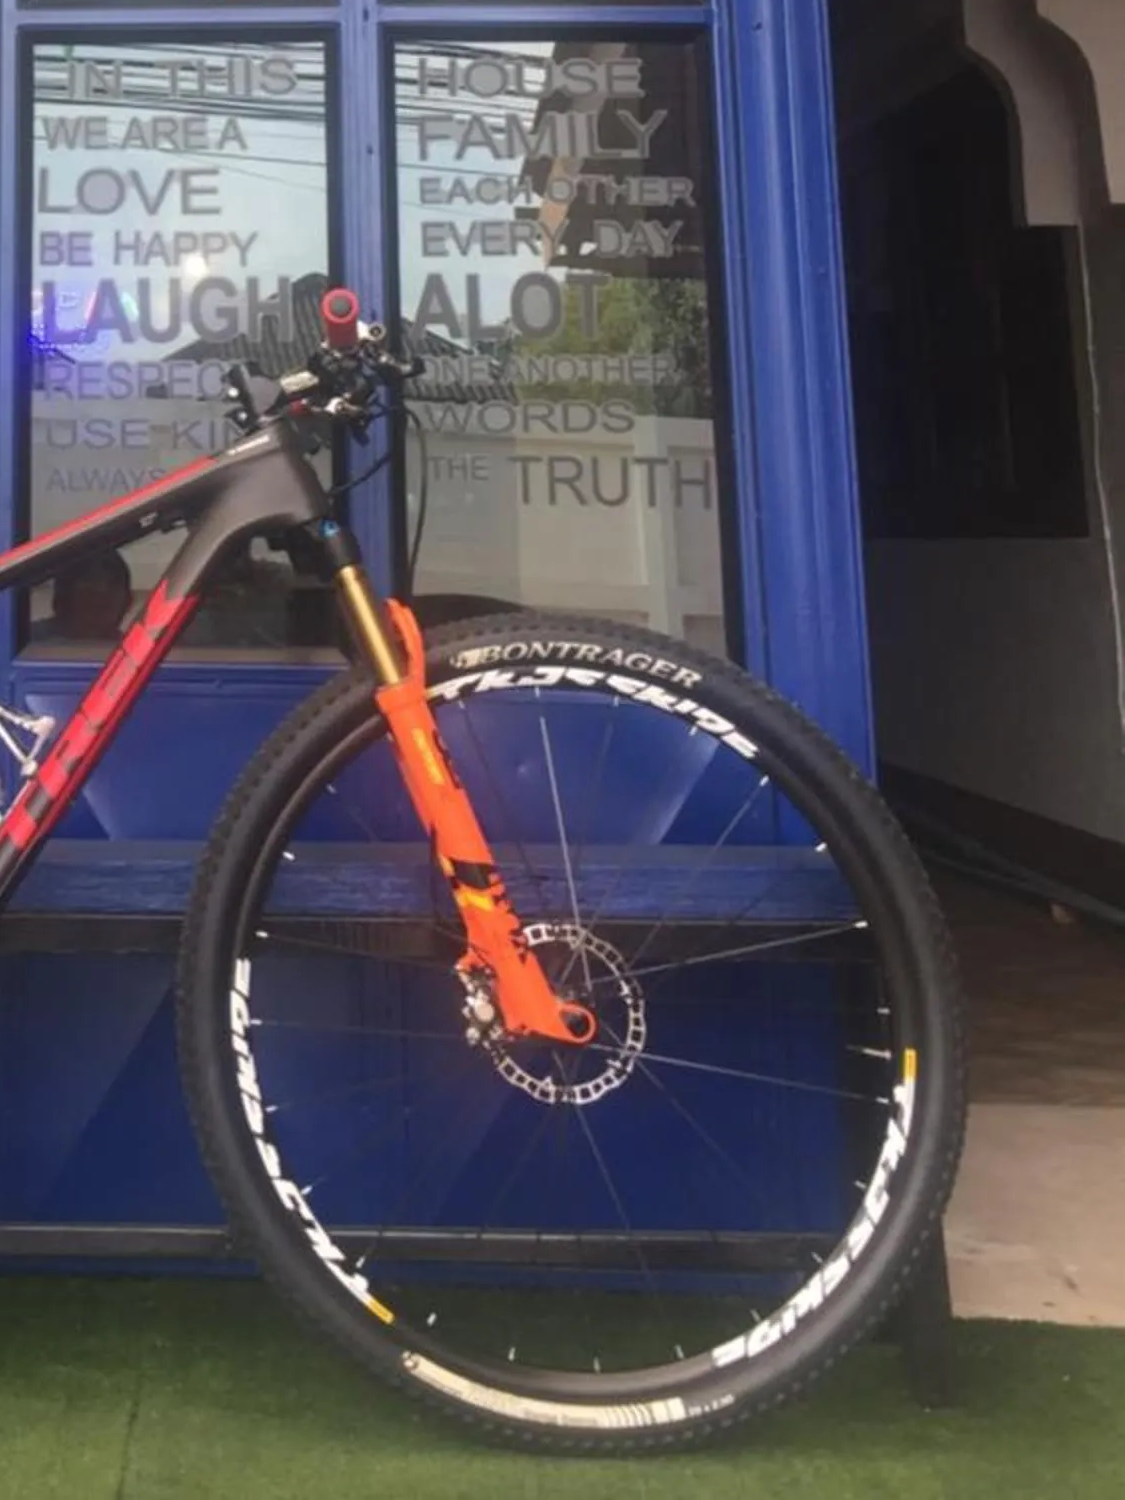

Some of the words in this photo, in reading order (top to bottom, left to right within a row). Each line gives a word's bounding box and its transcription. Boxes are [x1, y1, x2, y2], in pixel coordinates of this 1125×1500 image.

[65, 60, 123, 98] IN
[150, 58, 299, 98] THIS
[417, 58, 643, 99] HOUSE
[43, 115, 108, 151] WE
[120, 115, 207, 151] ARE
[215, 115, 249, 151] A
[417, 109, 668, 160] FAMILY
[37, 167, 223, 215] LOVE
[419, 176, 532, 205] EACH
[538, 176, 696, 207] OTHER
[39, 231, 92, 266] BE
[113, 231, 258, 266] HAPPY
[421, 220, 568, 258] EVERY
[597, 220, 684, 258] DAY
[41, 276, 294, 345] LAUGH
[44, 359, 227, 400] RESPEC
[502, 355, 677, 384] ANOTHER
[45, 418, 148, 450] USE
[173, 419, 241, 450] KIN
[424, 402, 635, 434] WORDS
[430, 456, 489, 481] THE
[508, 456, 711, 510] TRUTH
[481, 641, 703, 688] BONTRAGER
